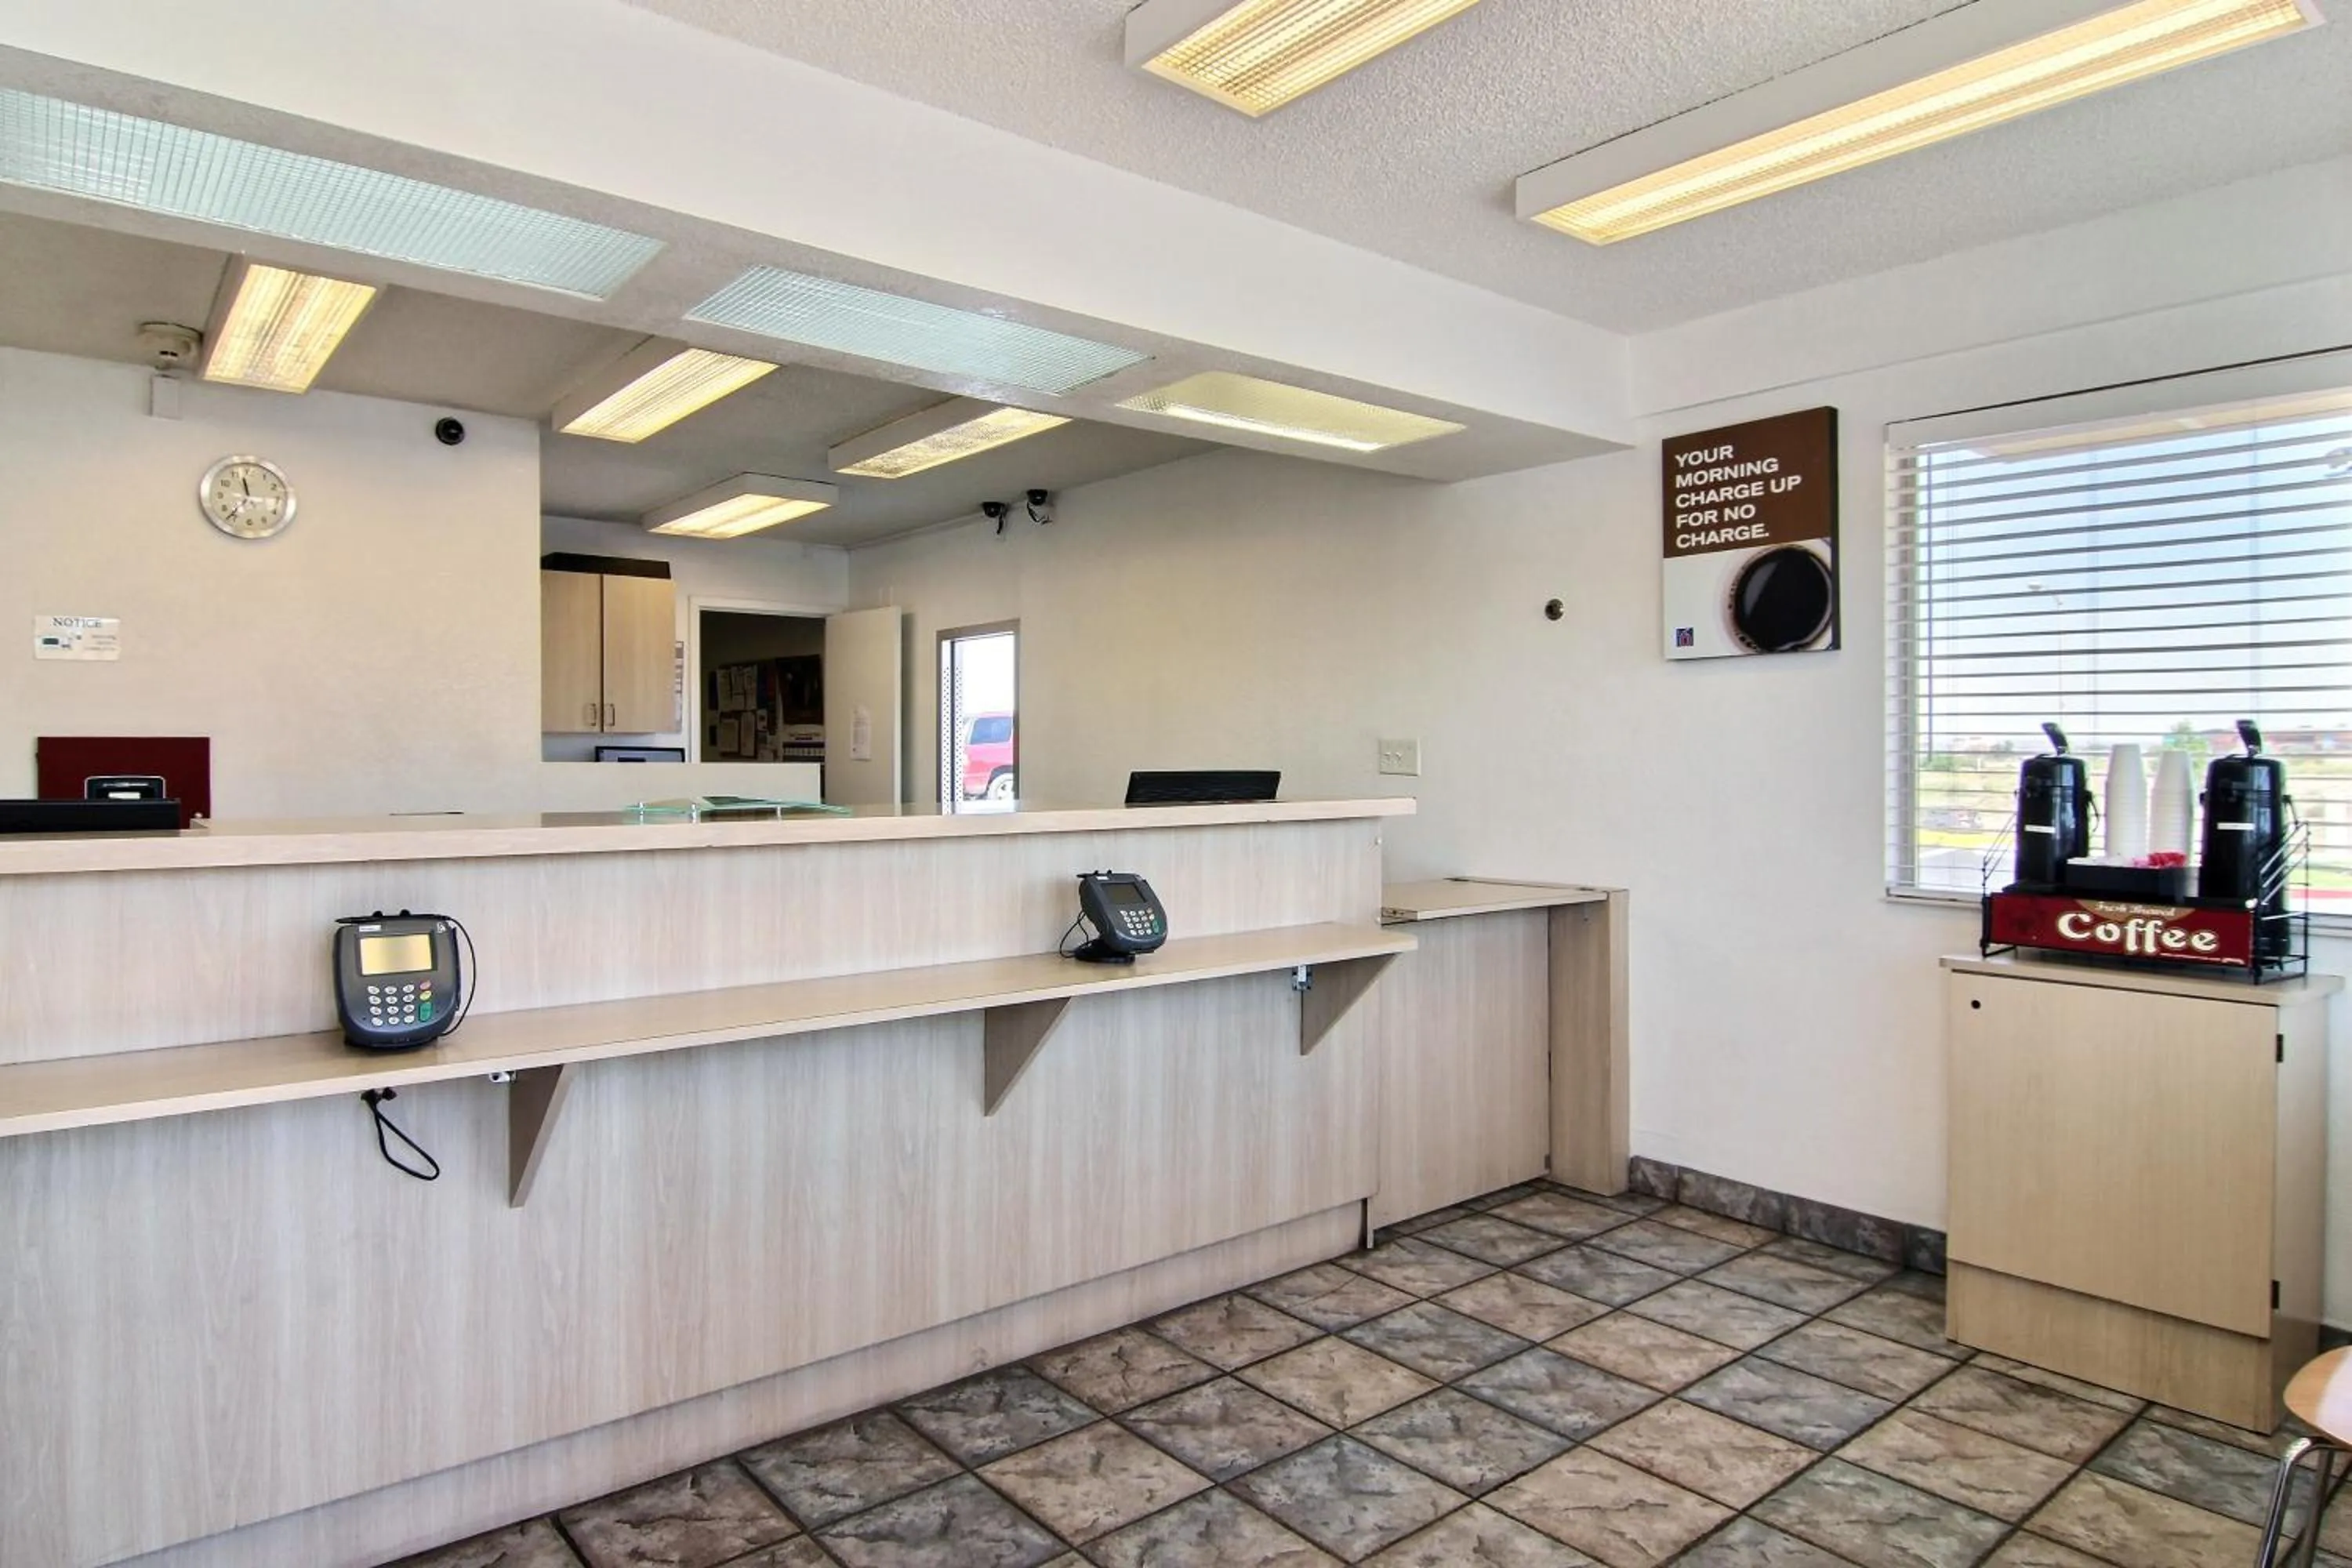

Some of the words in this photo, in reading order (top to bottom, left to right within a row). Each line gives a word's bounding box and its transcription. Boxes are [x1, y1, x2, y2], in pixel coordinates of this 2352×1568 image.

[1675, 445, 1734, 468] YOUR
[1675, 457, 1779, 488] MORNING
[1675, 481, 1765, 508] CHARGE
[1769, 475, 1802, 493] UP
[1676, 510, 1718, 528] FOR
[1724, 504, 1755, 521] NO
[1676, 523, 1769, 549] CHARGE.
[52, 617, 102, 628] NOTICE
[2057, 912, 2220, 954] Coffee
